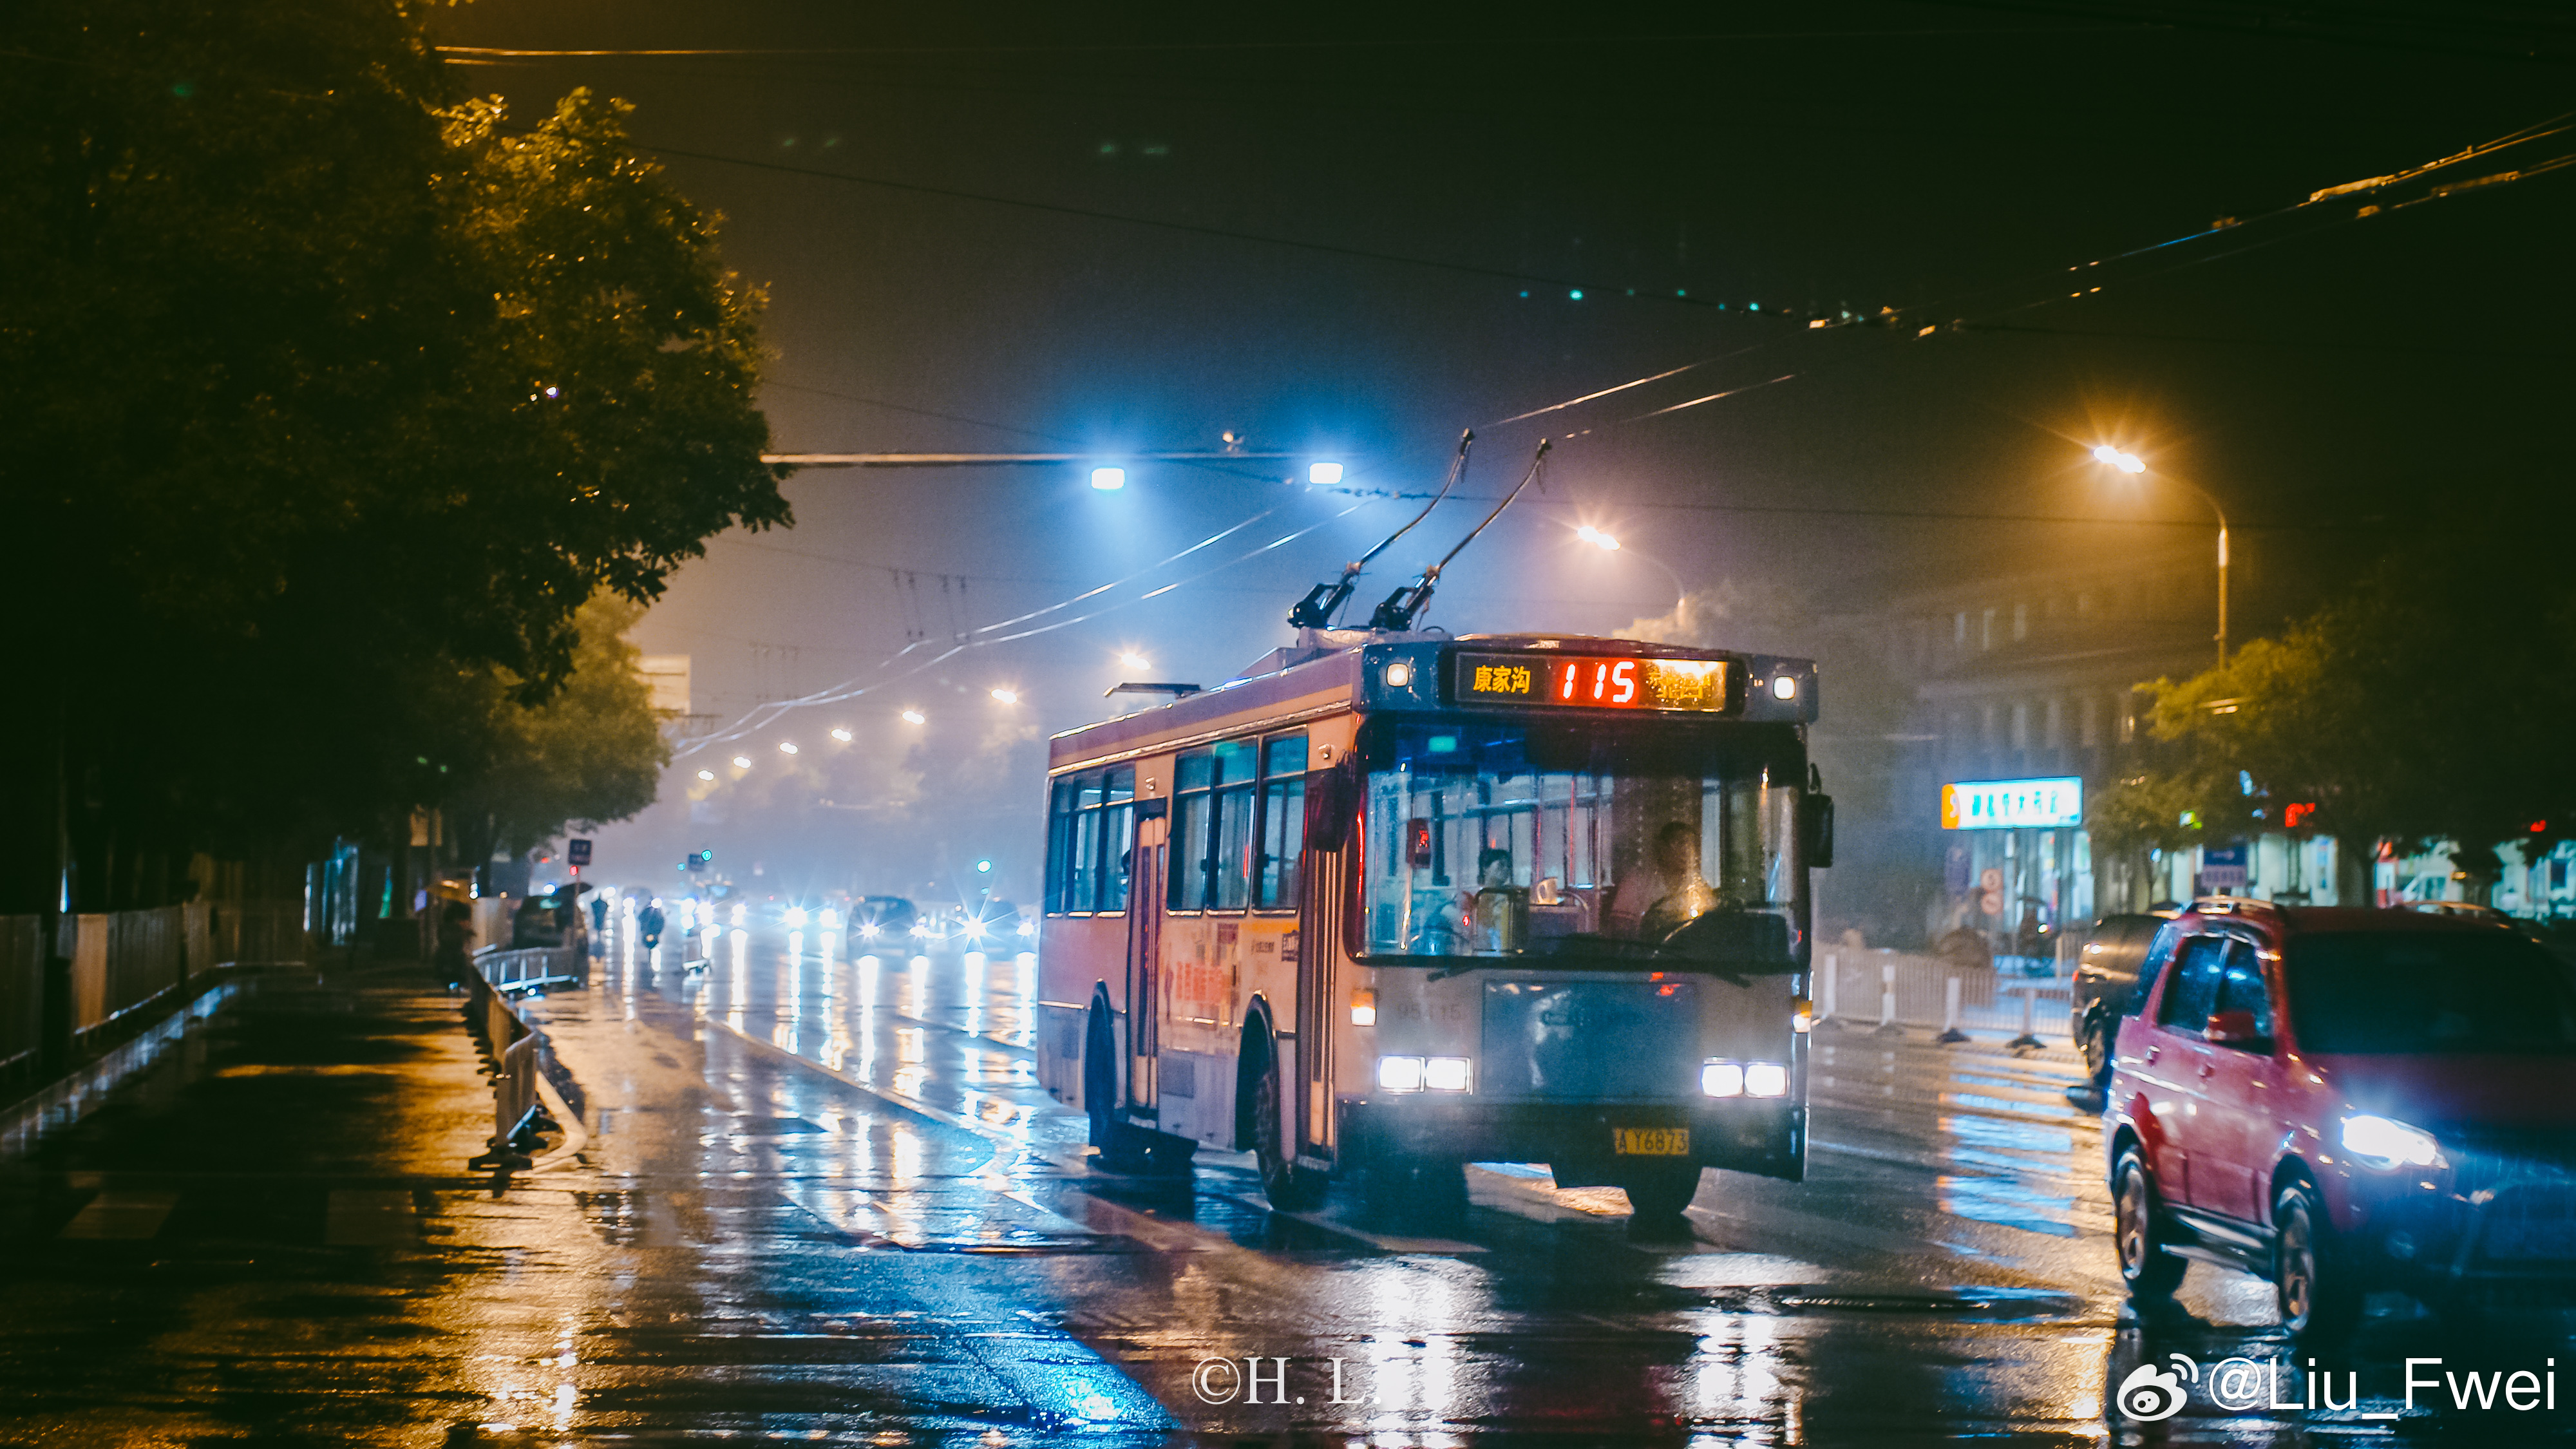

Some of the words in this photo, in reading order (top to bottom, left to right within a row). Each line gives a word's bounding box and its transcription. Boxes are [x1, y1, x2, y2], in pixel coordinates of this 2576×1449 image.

[1473, 665, 1530, 694] 康家沟
[1562, 661, 1636, 703] 115
